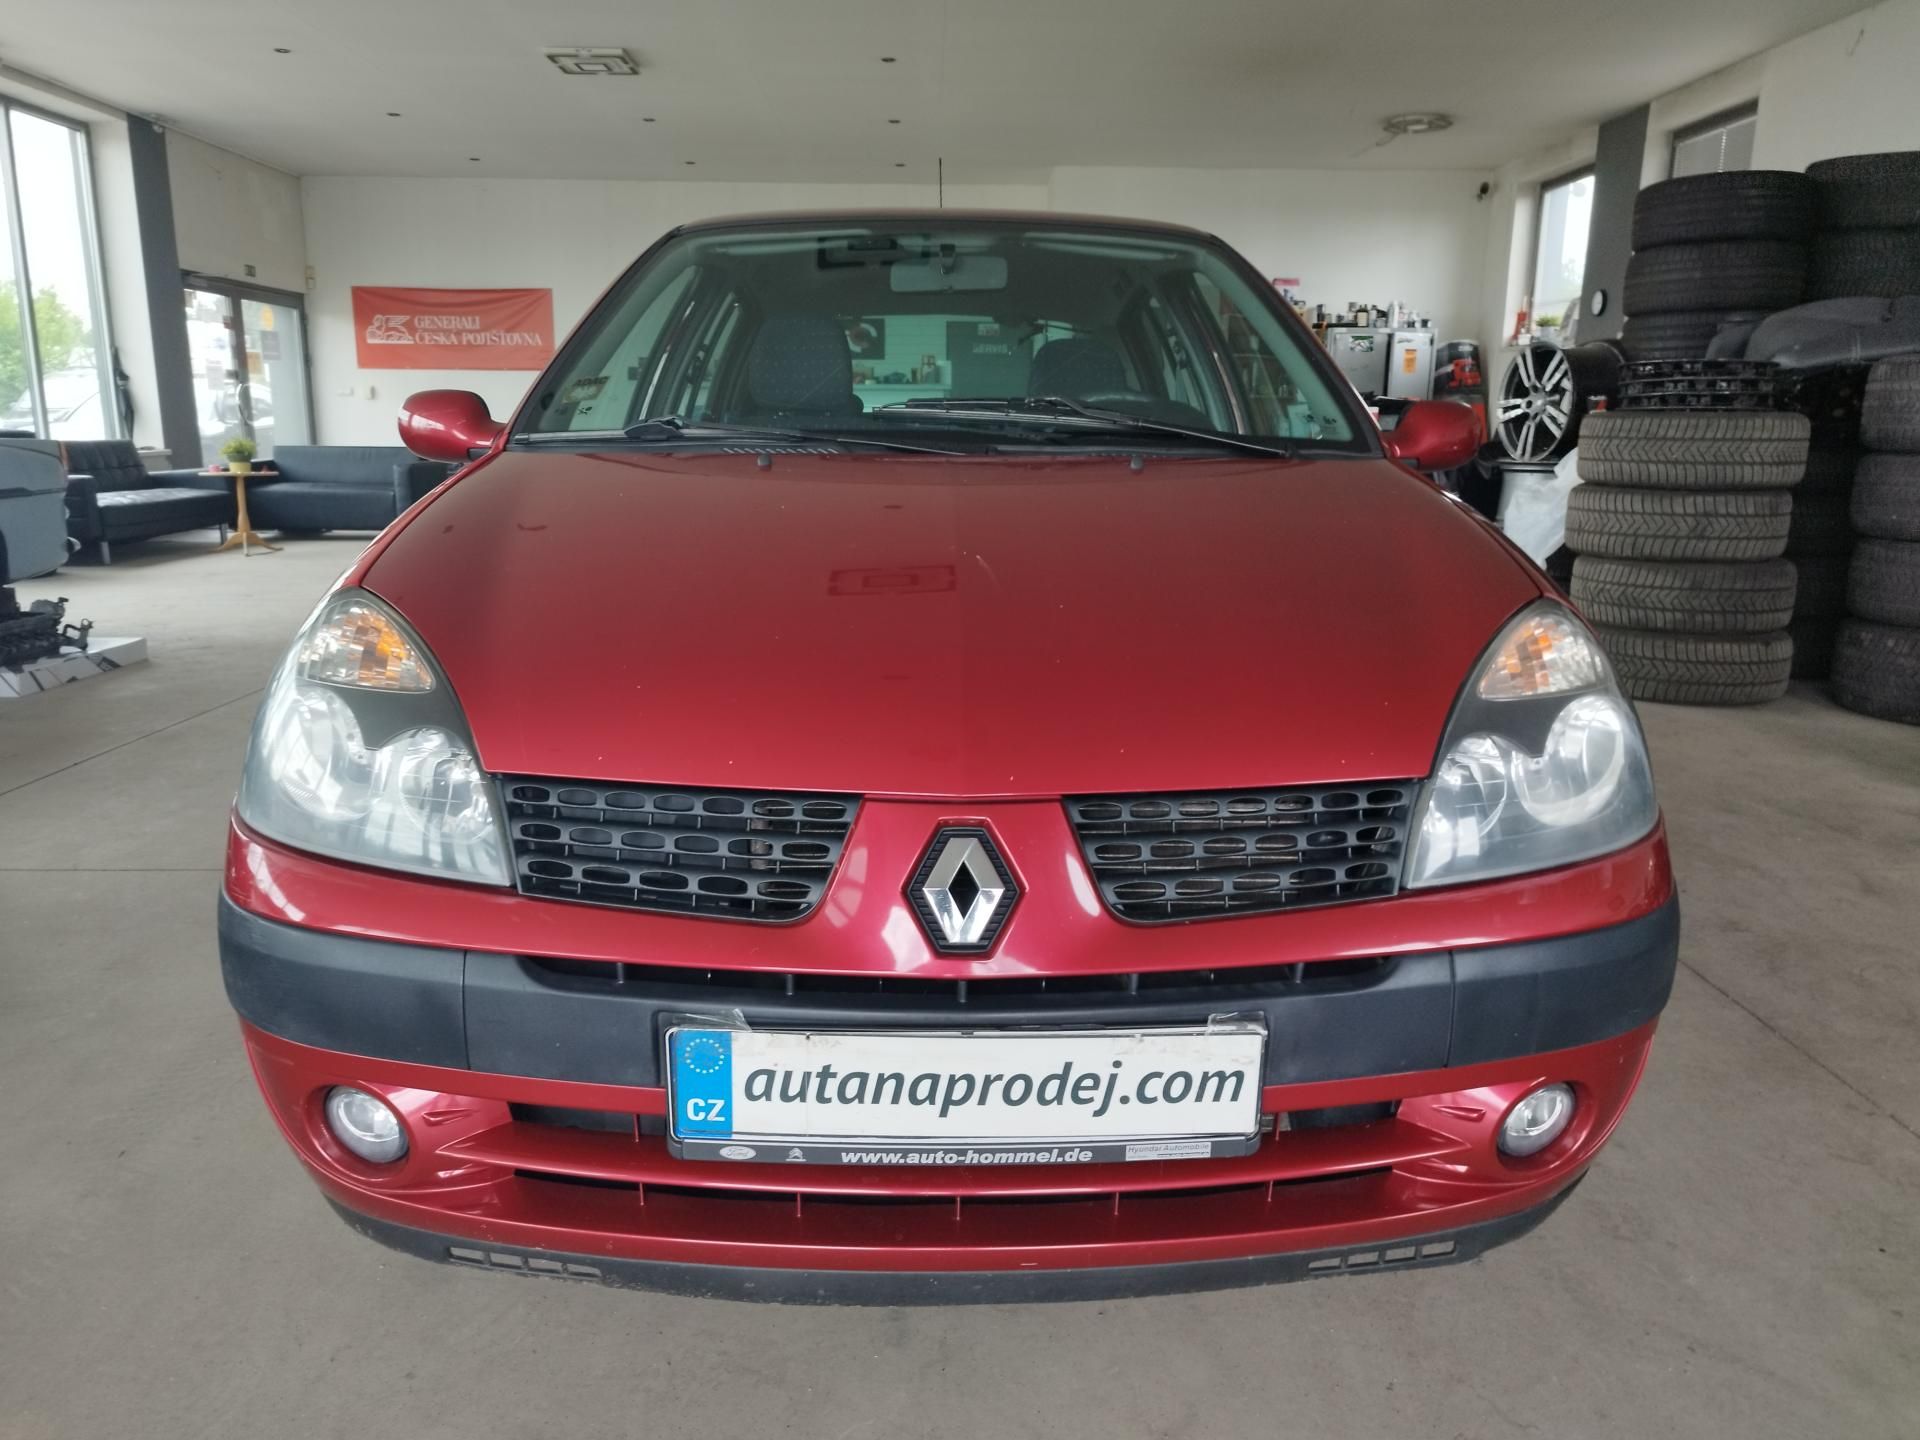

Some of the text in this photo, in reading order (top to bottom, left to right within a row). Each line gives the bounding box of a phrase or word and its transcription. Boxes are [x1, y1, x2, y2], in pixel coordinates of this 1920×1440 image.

[414, 314, 480, 330] GENERALI
[744, 1060, 1245, 1118] autanaprodej.com
[686, 1098, 726, 1122] CZ
[841, 1148, 1093, 1164] www.auto-hommel.de
